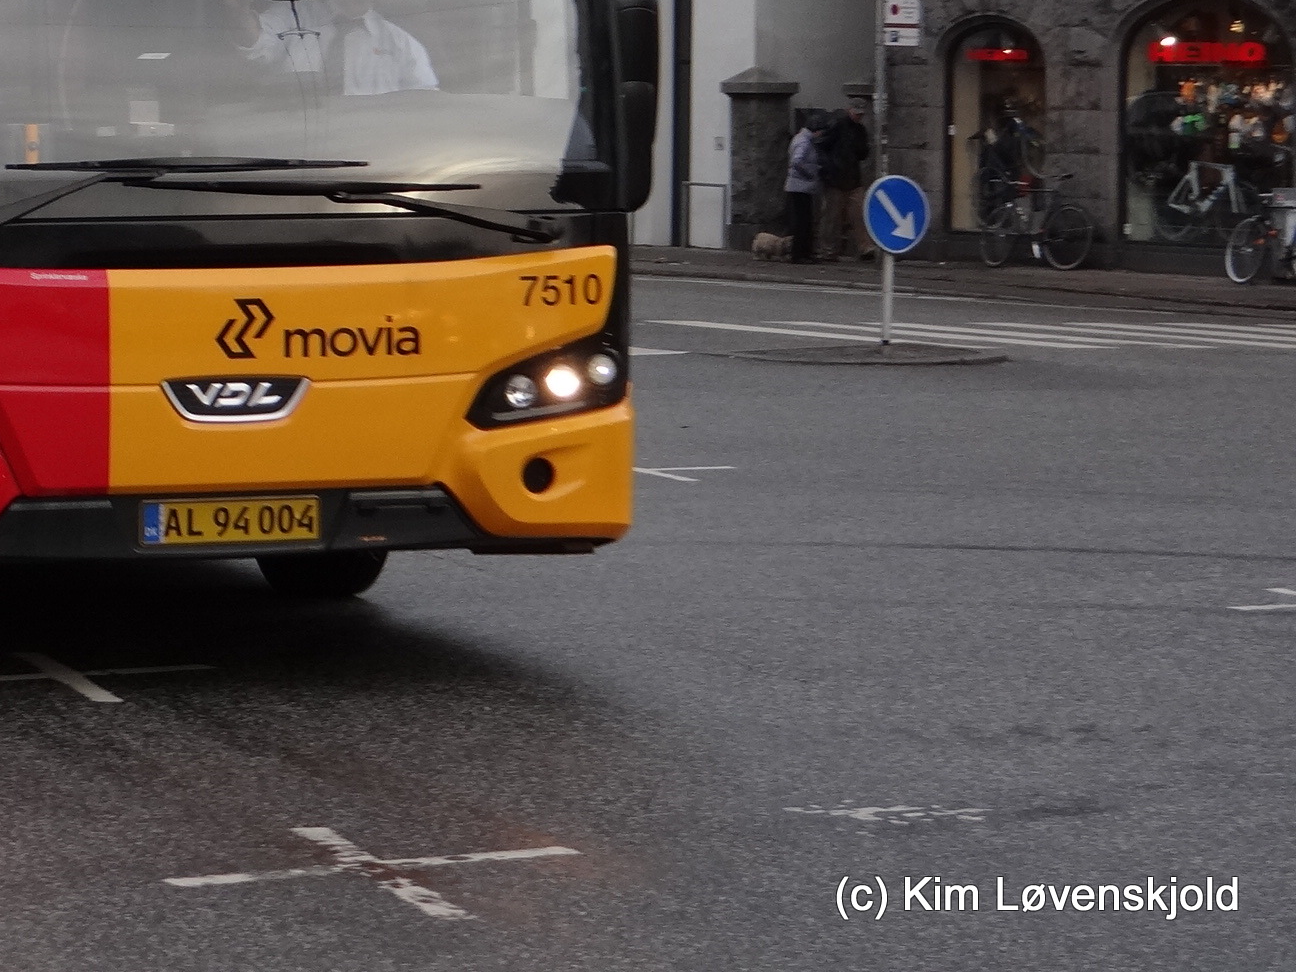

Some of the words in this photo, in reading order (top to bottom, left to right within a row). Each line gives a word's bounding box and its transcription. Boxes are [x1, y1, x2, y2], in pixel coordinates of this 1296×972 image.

[519, 274, 604, 307] 7510
[282, 314, 423, 359] movia
[185, 381, 283, 408] VDL
[164, 508, 204, 538] AL
[212, 505, 251, 537] 94
[257, 503, 316, 535] 004
